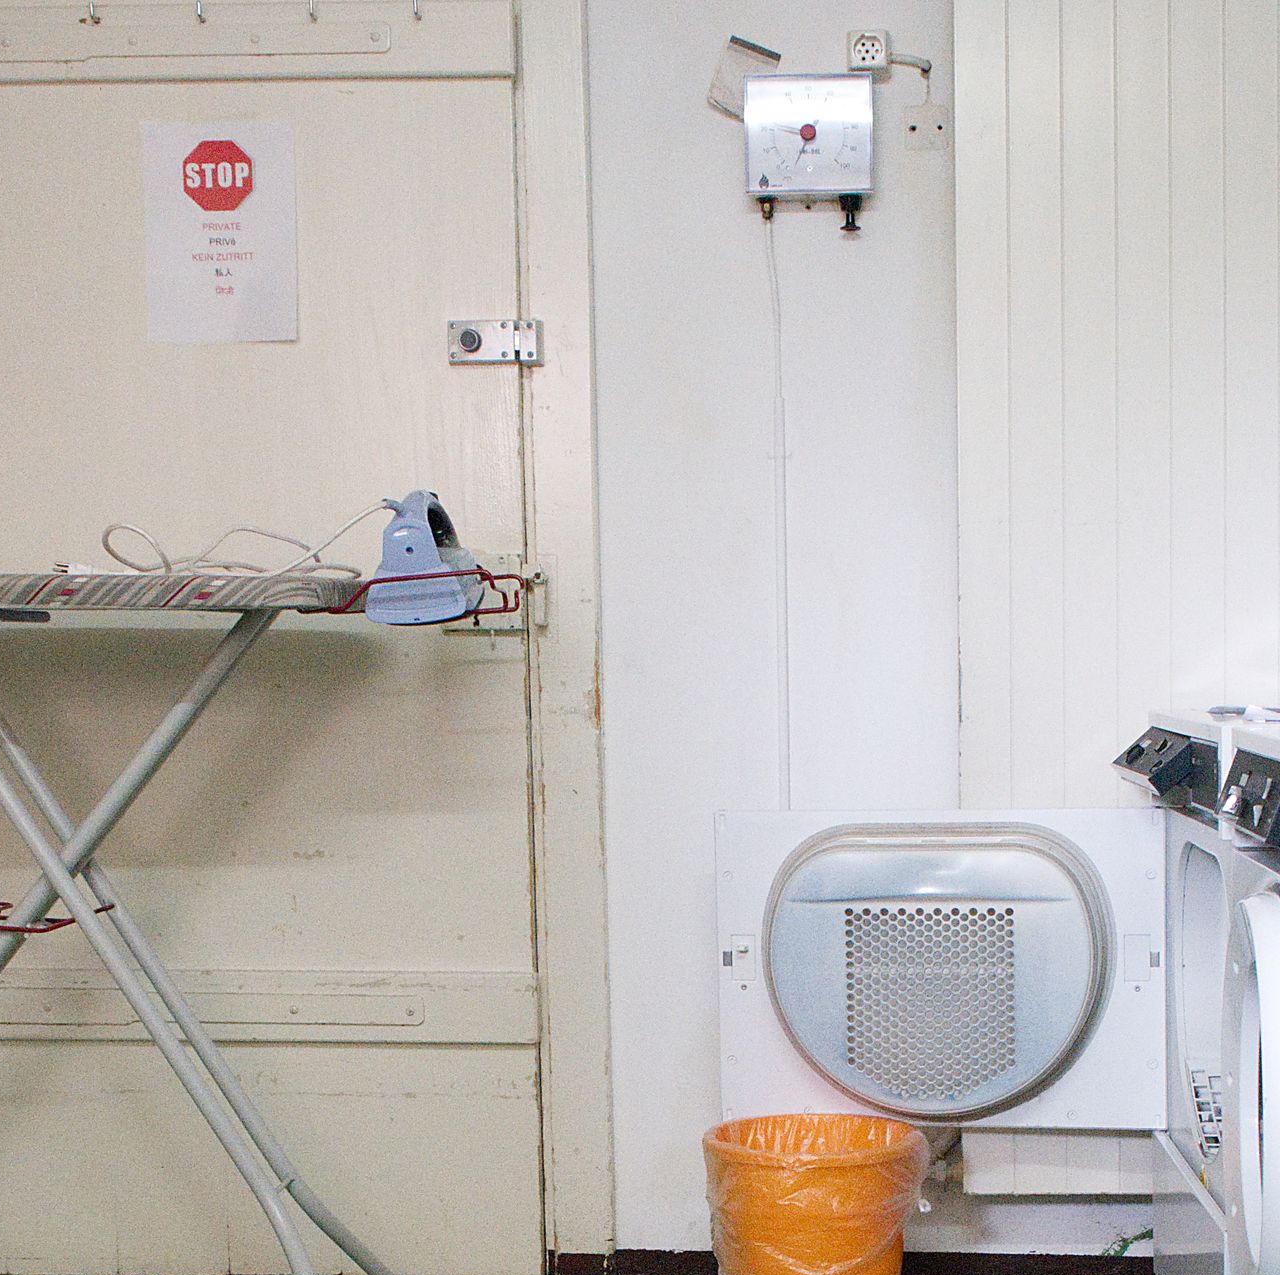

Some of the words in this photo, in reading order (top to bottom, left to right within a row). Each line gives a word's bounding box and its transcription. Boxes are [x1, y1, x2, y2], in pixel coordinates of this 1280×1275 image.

[185, 162, 250, 189] STOP
[202, 222, 241, 231] PRIVATE
[192, 253, 214, 262] KEIN
[216, 252, 254, 262] ZUTRITT
